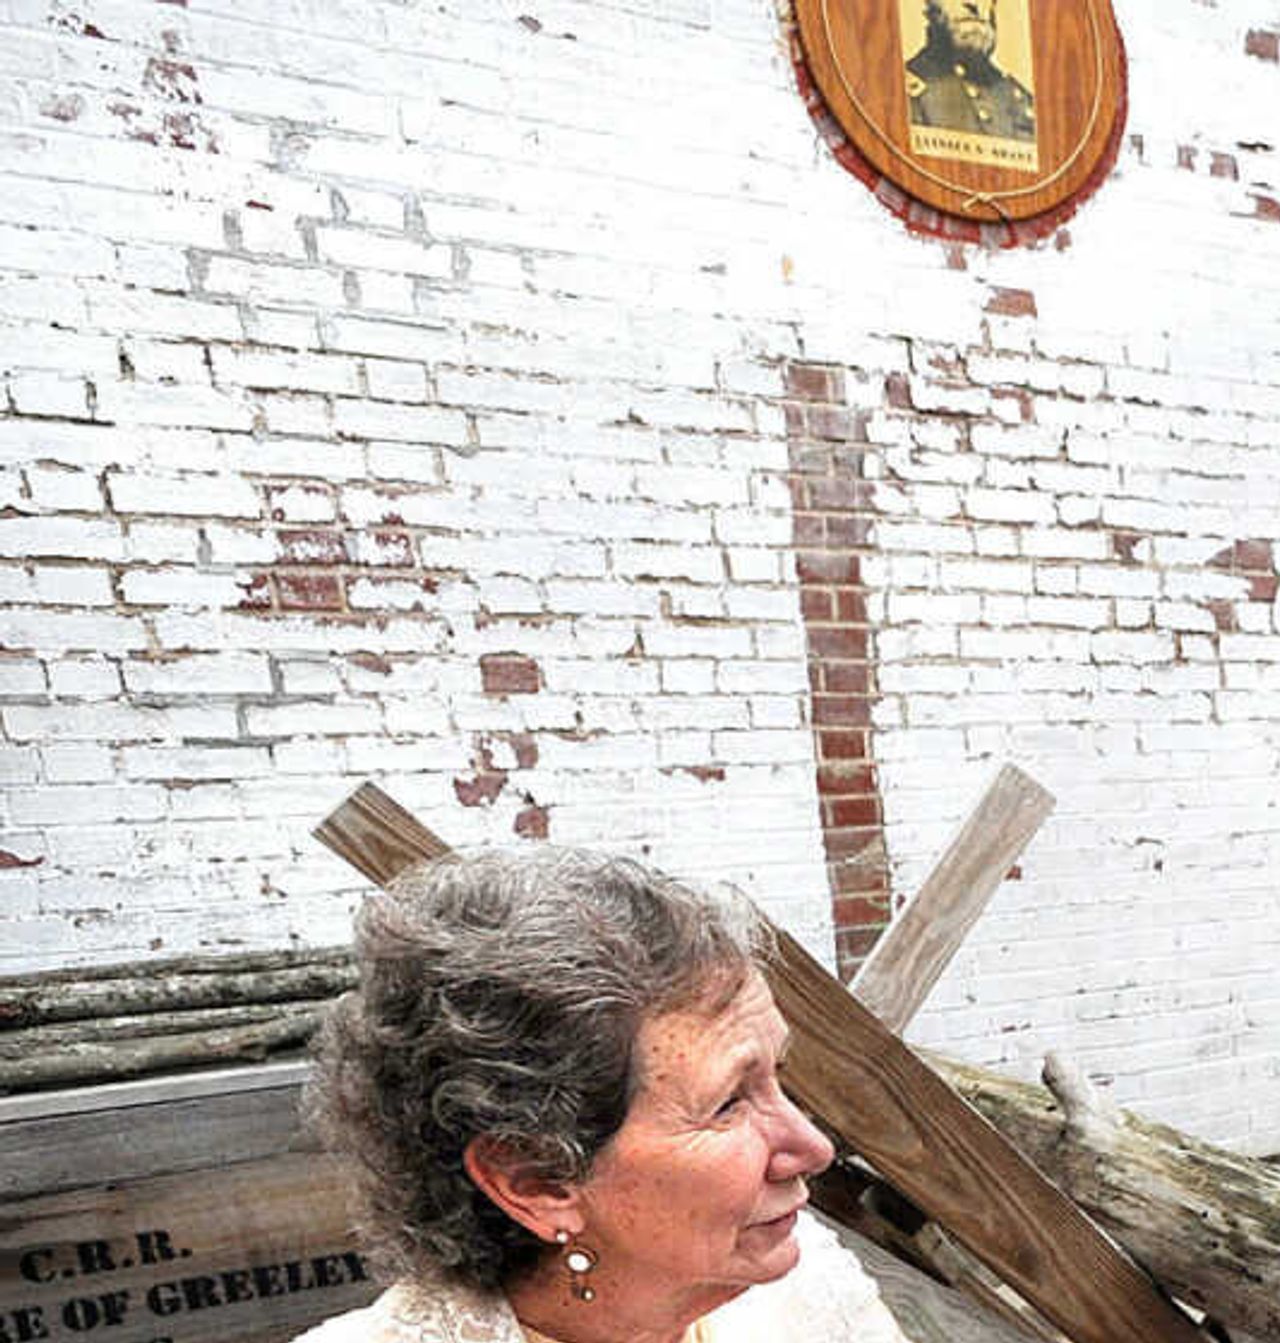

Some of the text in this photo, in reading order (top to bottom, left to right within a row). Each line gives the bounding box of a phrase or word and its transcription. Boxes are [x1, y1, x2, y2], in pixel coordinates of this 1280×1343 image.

[20, 1231, 192, 1283] C.R.R.
[62, 1290, 130, 1331] OF
[147, 1252, 369, 1316] GREELEY
